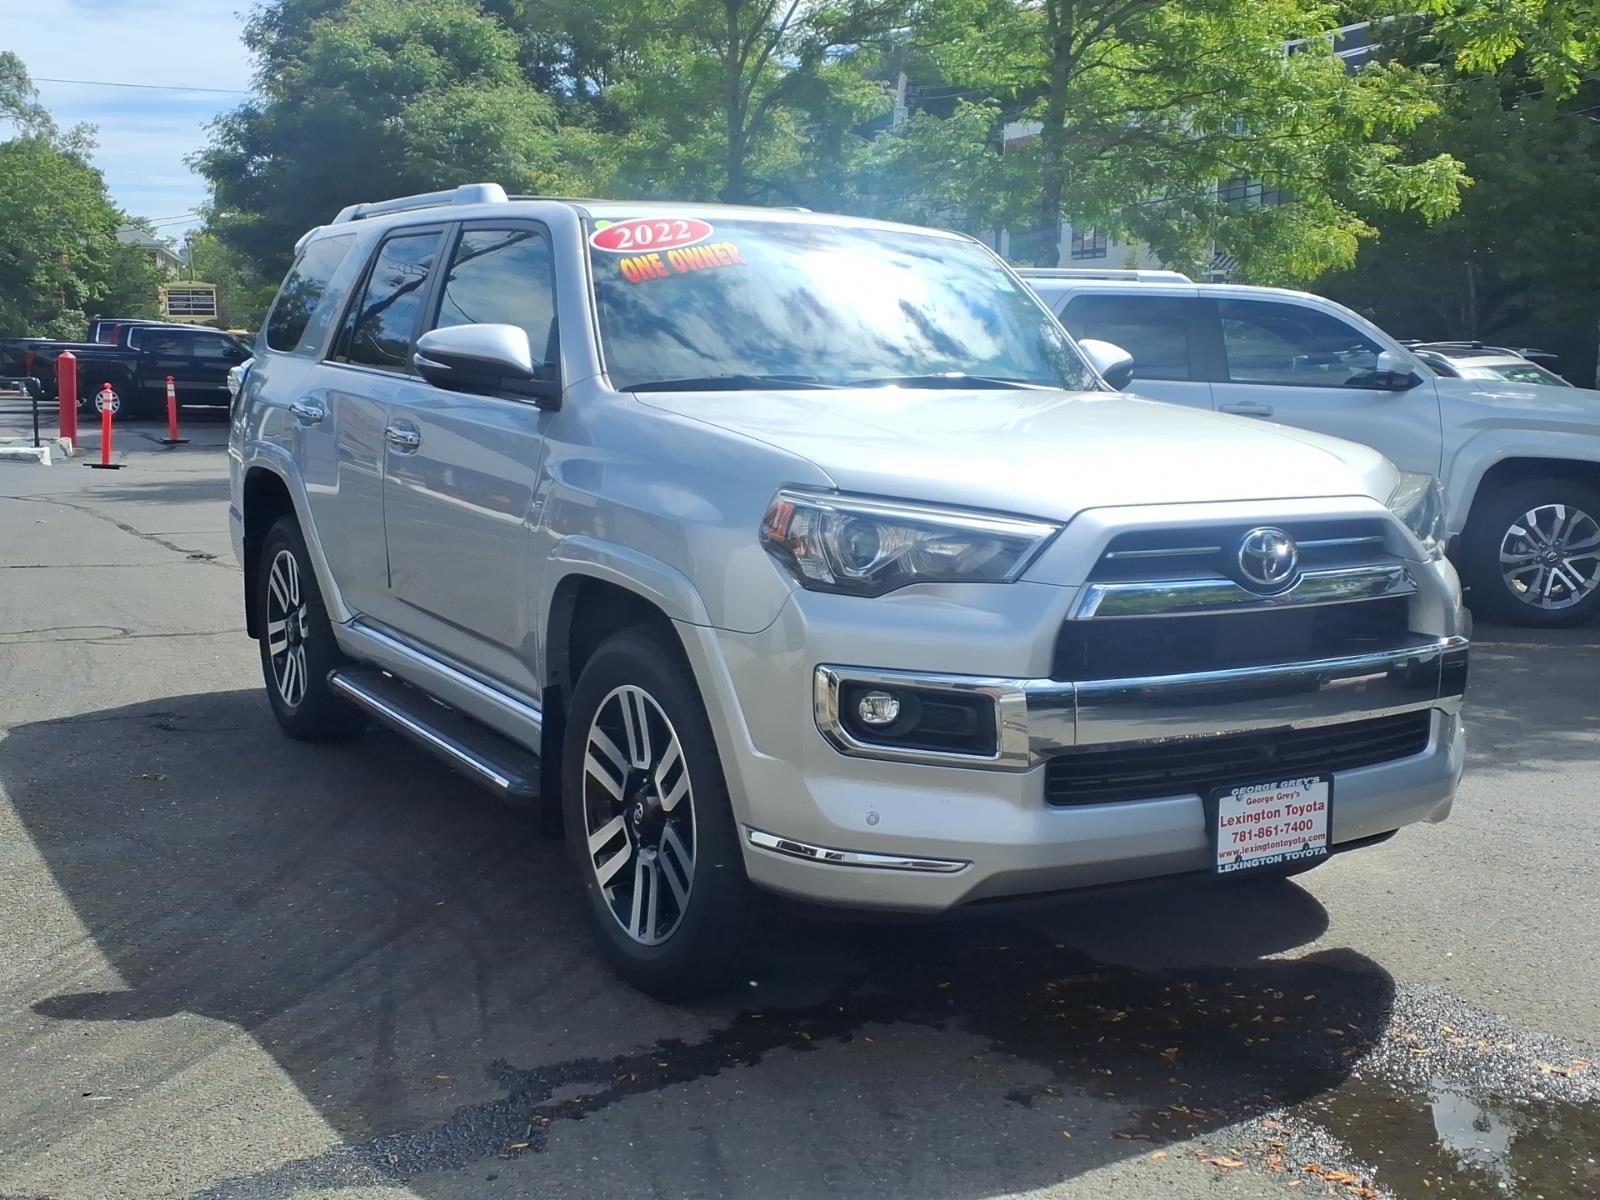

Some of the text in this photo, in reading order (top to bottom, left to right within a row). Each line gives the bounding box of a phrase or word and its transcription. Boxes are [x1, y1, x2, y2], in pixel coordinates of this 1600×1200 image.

[614, 220, 691, 249] 2022
[619, 242, 747, 284] ONE OWNER
[1231, 782, 1277, 796] GEORGE
[1246, 790, 1301, 806] George Grey's
[1220, 800, 1325, 828] Lexington Toyota
[1232, 819, 1313, 844] 781-861-7400
[1219, 833, 1326, 858] www.lexingtontoyota.com
[1218, 847, 1327, 873] LEXINGTON TOYOTA
